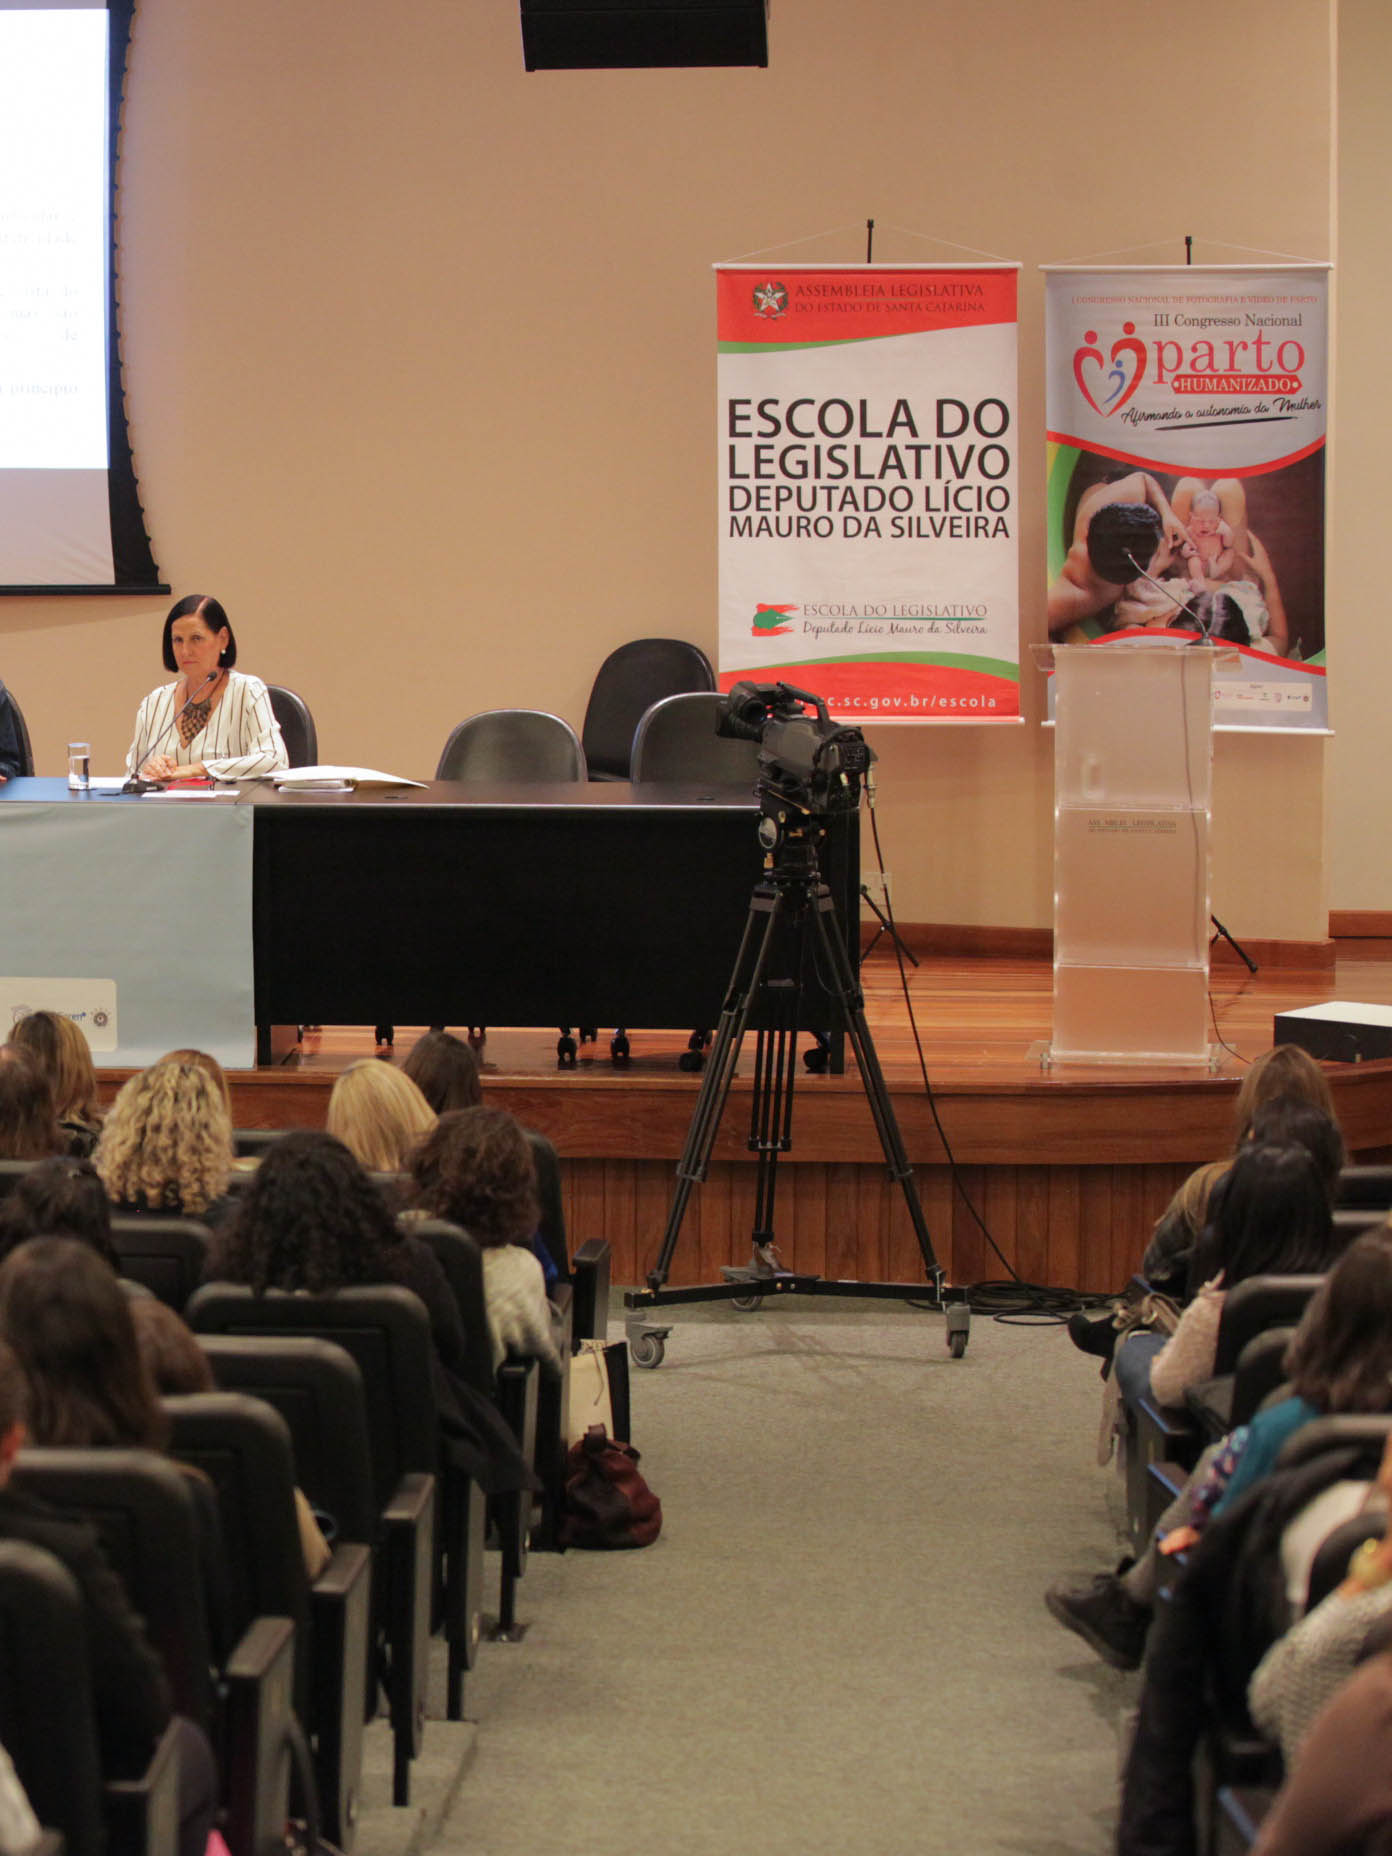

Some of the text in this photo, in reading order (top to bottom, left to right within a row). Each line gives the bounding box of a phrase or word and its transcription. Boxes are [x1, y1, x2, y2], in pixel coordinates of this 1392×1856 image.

[795, 284, 984, 297] ASSEMBLEIA LEGISLATIVA
[817, 302, 862, 312] ESTADO
[865, 302, 882, 312] DE
[885, 302, 923, 312] SANTA
[925, 302, 985, 312] CATARINA
[1153, 313, 1303, 330] III Congresso Nacional
[1152, 328, 1306, 385] parto
[1180, 377, 1291, 393] HUMANIZADO
[728, 398, 1010, 439] ESCOLA DO
[1120, 397, 1322, 427] Afirmando a autonomia da Mulher
[728, 443, 1010, 480] LEGISLATIVO
[728, 480, 1010, 513] DEPUTADO LÍCIO
[729, 515, 1010, 539] MAURO DA SILVEIRA
[803, 604, 988, 617] ESCOLA DO LEGISLATIVO
[802, 620, 854, 640] Deputado
[887, 621, 924, 635] Mauro
[927, 620, 942, 634] da
[944, 620, 988, 635] Silveira
[826, 694, 997, 710] c.sc.gov.br/escola
